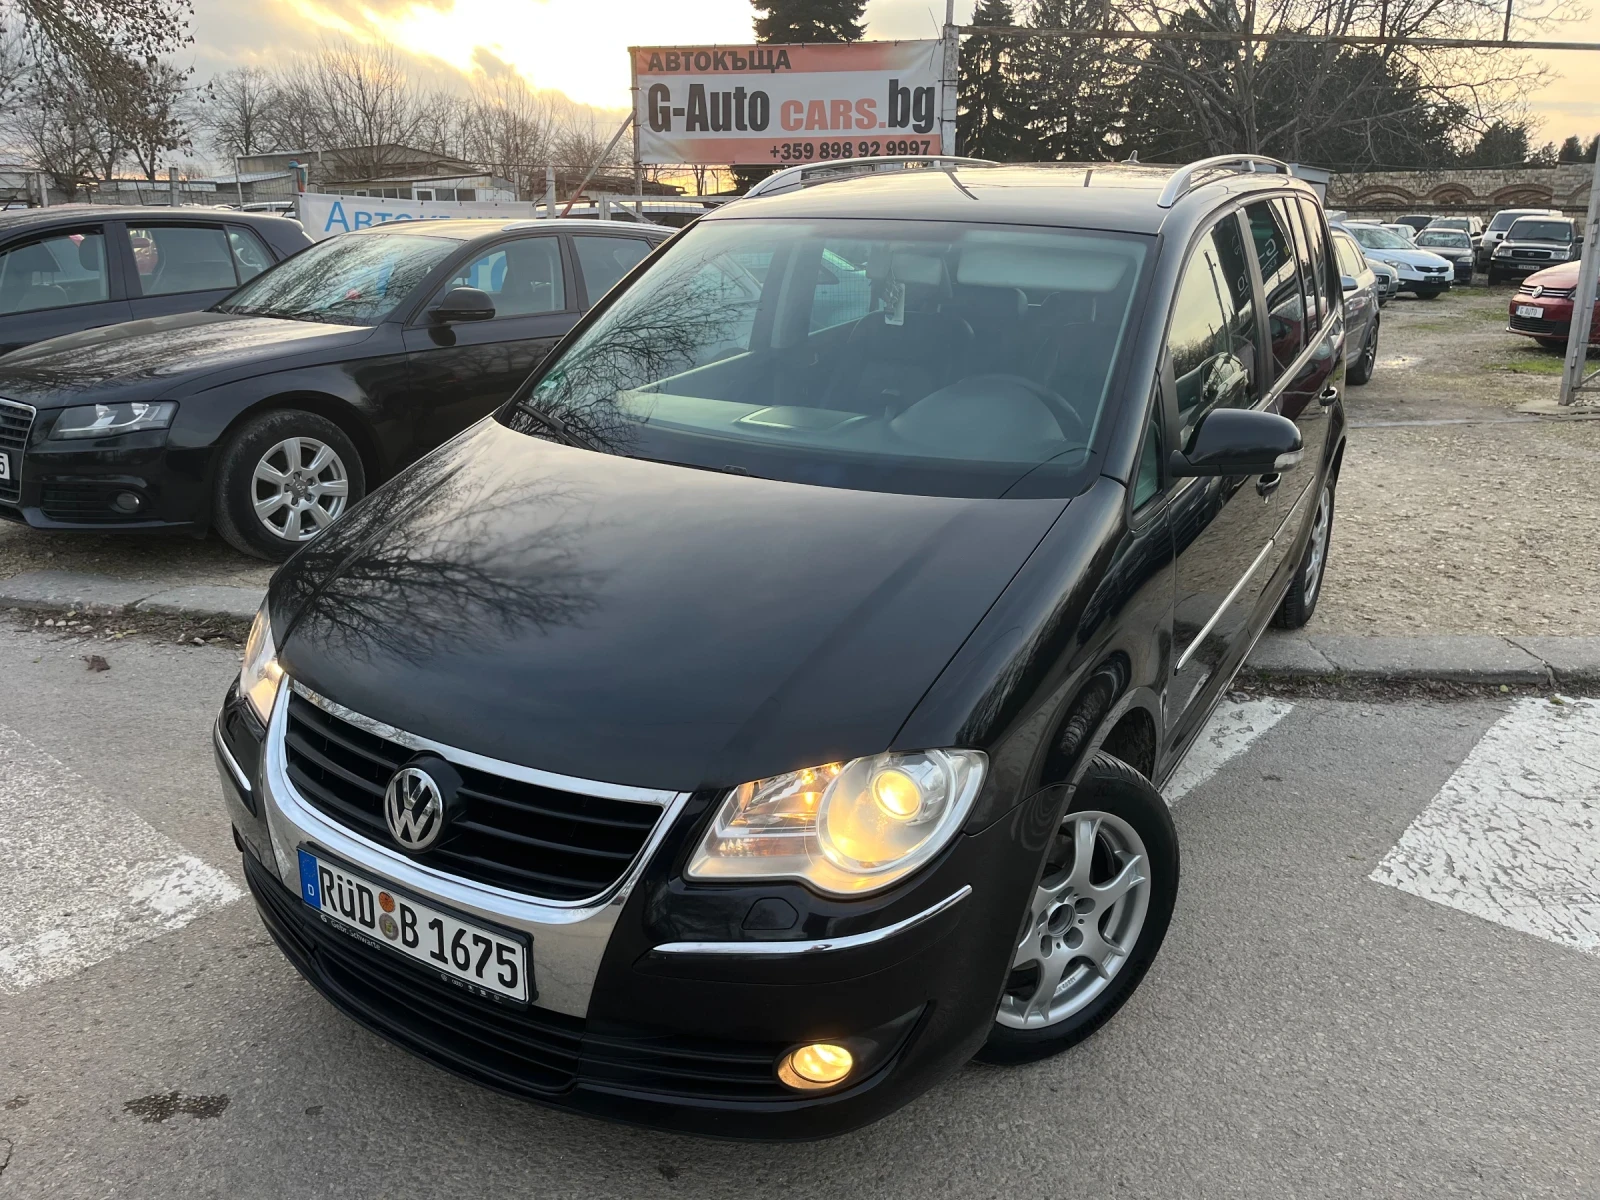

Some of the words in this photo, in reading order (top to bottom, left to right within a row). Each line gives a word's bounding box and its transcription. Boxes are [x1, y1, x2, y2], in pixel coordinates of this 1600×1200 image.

[648, 50, 792, 73] АВТОКЪЩА
[649, 82, 770, 132] G-Auto
[769, 142, 815, 161] +359
[818, 141, 854, 160] 898
[858, 140, 881, 158] 92
[885, 139, 932, 156] 9997
[306, 883, 315, 897] D
[399, 902, 420, 949] B
[428, 917, 518, 990] 1675
